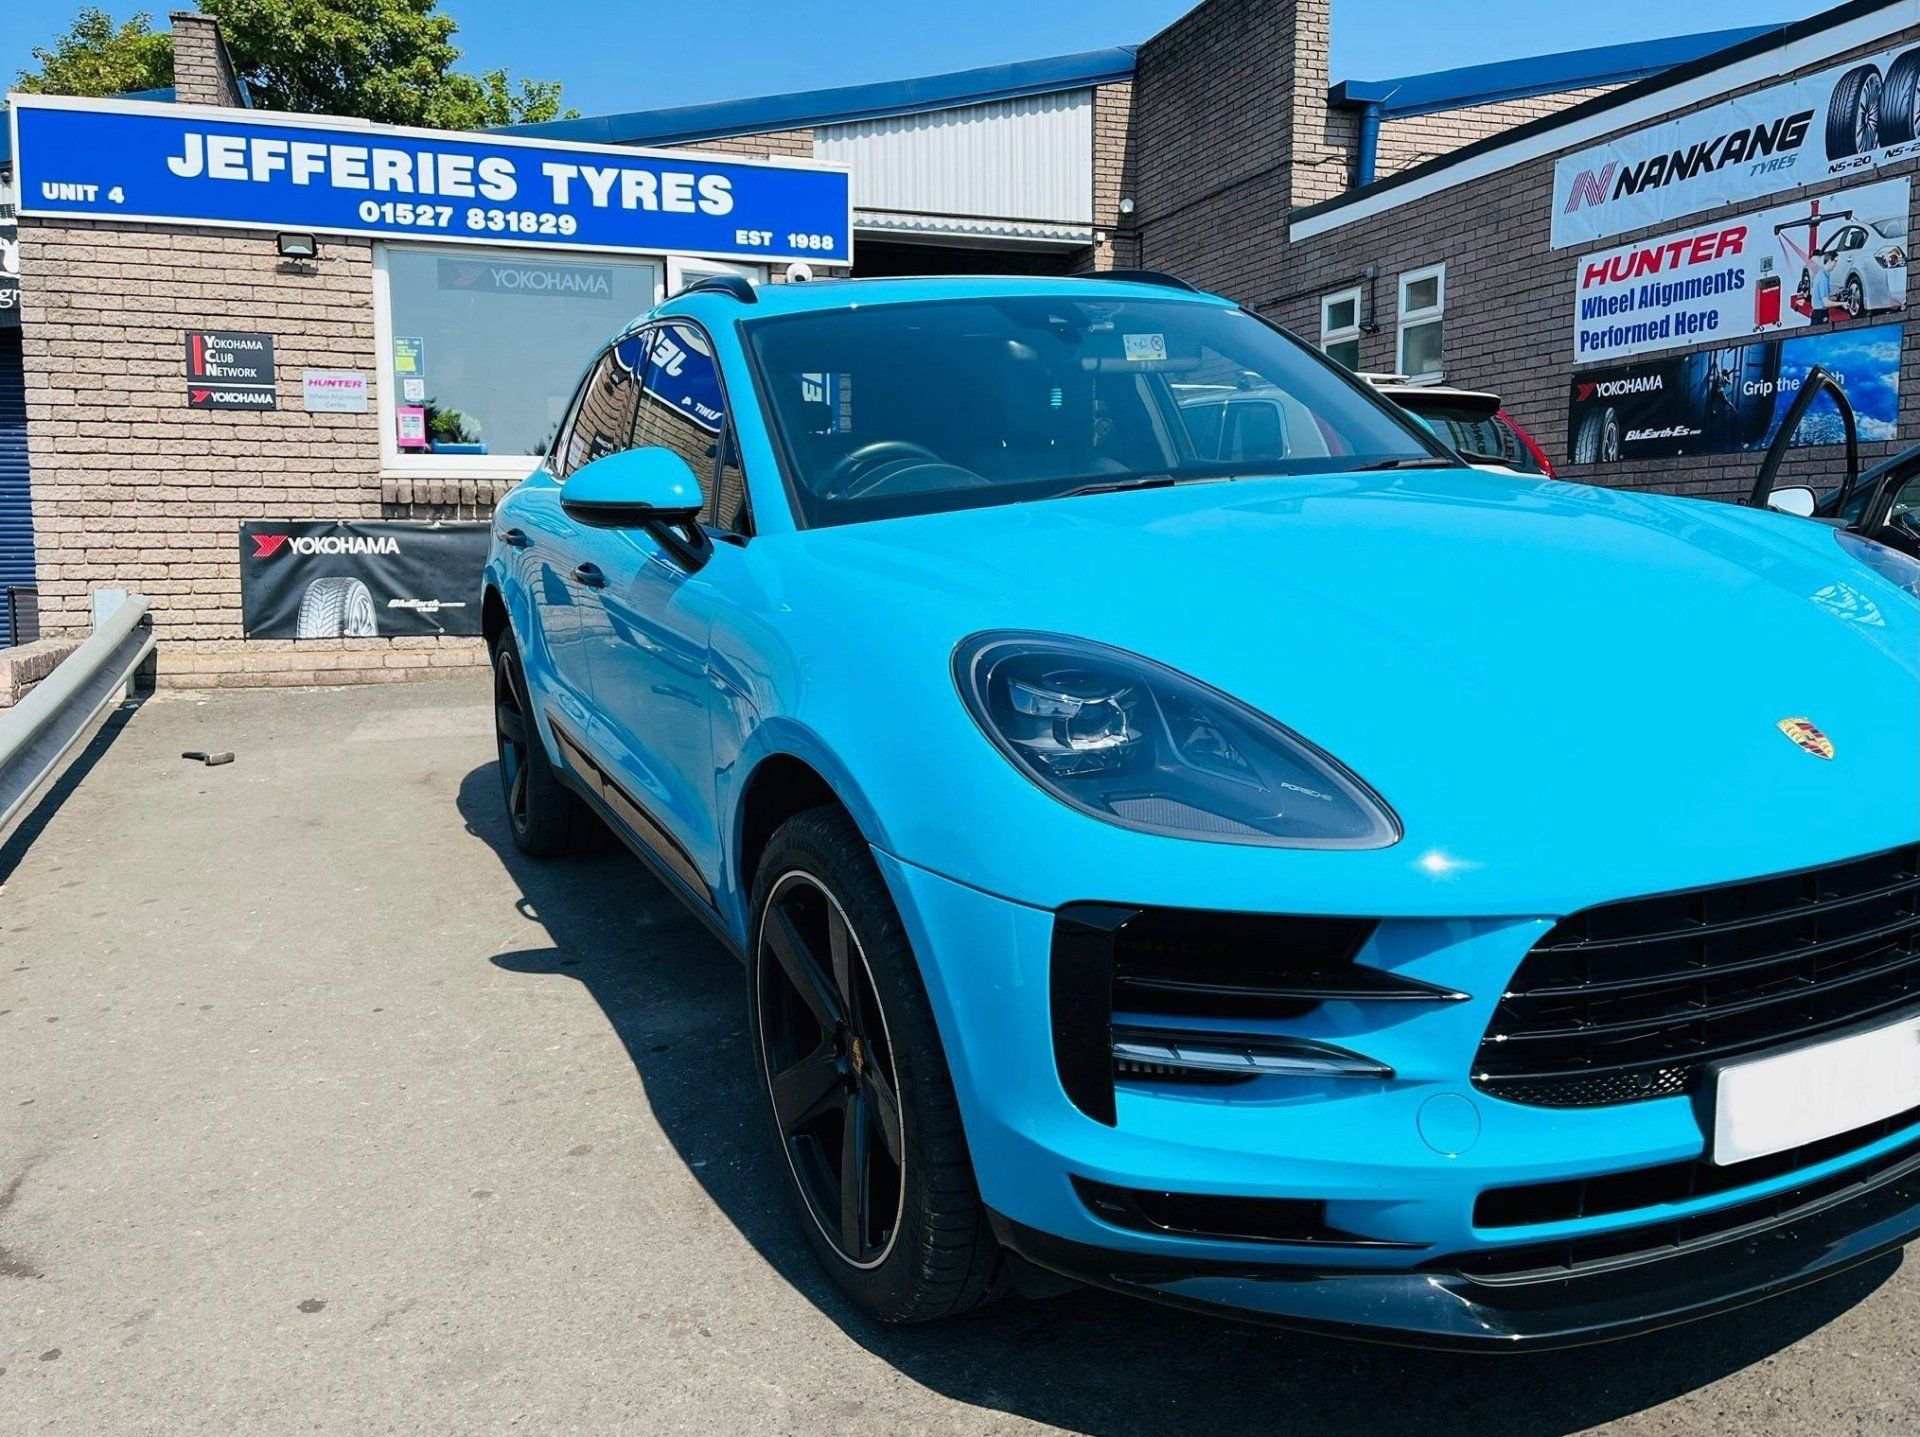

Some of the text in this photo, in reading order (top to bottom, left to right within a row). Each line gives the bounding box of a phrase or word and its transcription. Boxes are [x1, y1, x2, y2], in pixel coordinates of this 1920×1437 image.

[1612, 109, 1815, 201] NANKANG
[1750, 153, 1798, 177] TYRES
[1828, 155, 1872, 174] NS-20
[167, 133, 734, 216] JEFFERIES TYRES
[42, 182, 125, 204] UNIT 4
[358, 200, 577, 236] 01527 831829
[736, 229, 834, 251] EST 1988
[1582, 225, 1747, 289] HUNTER
[490, 268, 610, 294] YOKOHAMA
[1581, 267, 1745, 320] Wheel Alignments
[1580, 309, 1719, 352] Performed Here
[203, 335, 263, 350] YOKOHAMA
[204, 349, 234, 364] CLUB
[205, 363, 257, 378] NETWORK
[308, 378, 362, 389] HUNTER
[1595, 374, 1663, 398] YOKOHAMA
[1743, 380, 1773, 397] Grip
[1777, 377, 1800, 392] the
[210, 391, 274, 404] YOKOHAMA
[287, 536, 400, 555] YOKOHAMA
